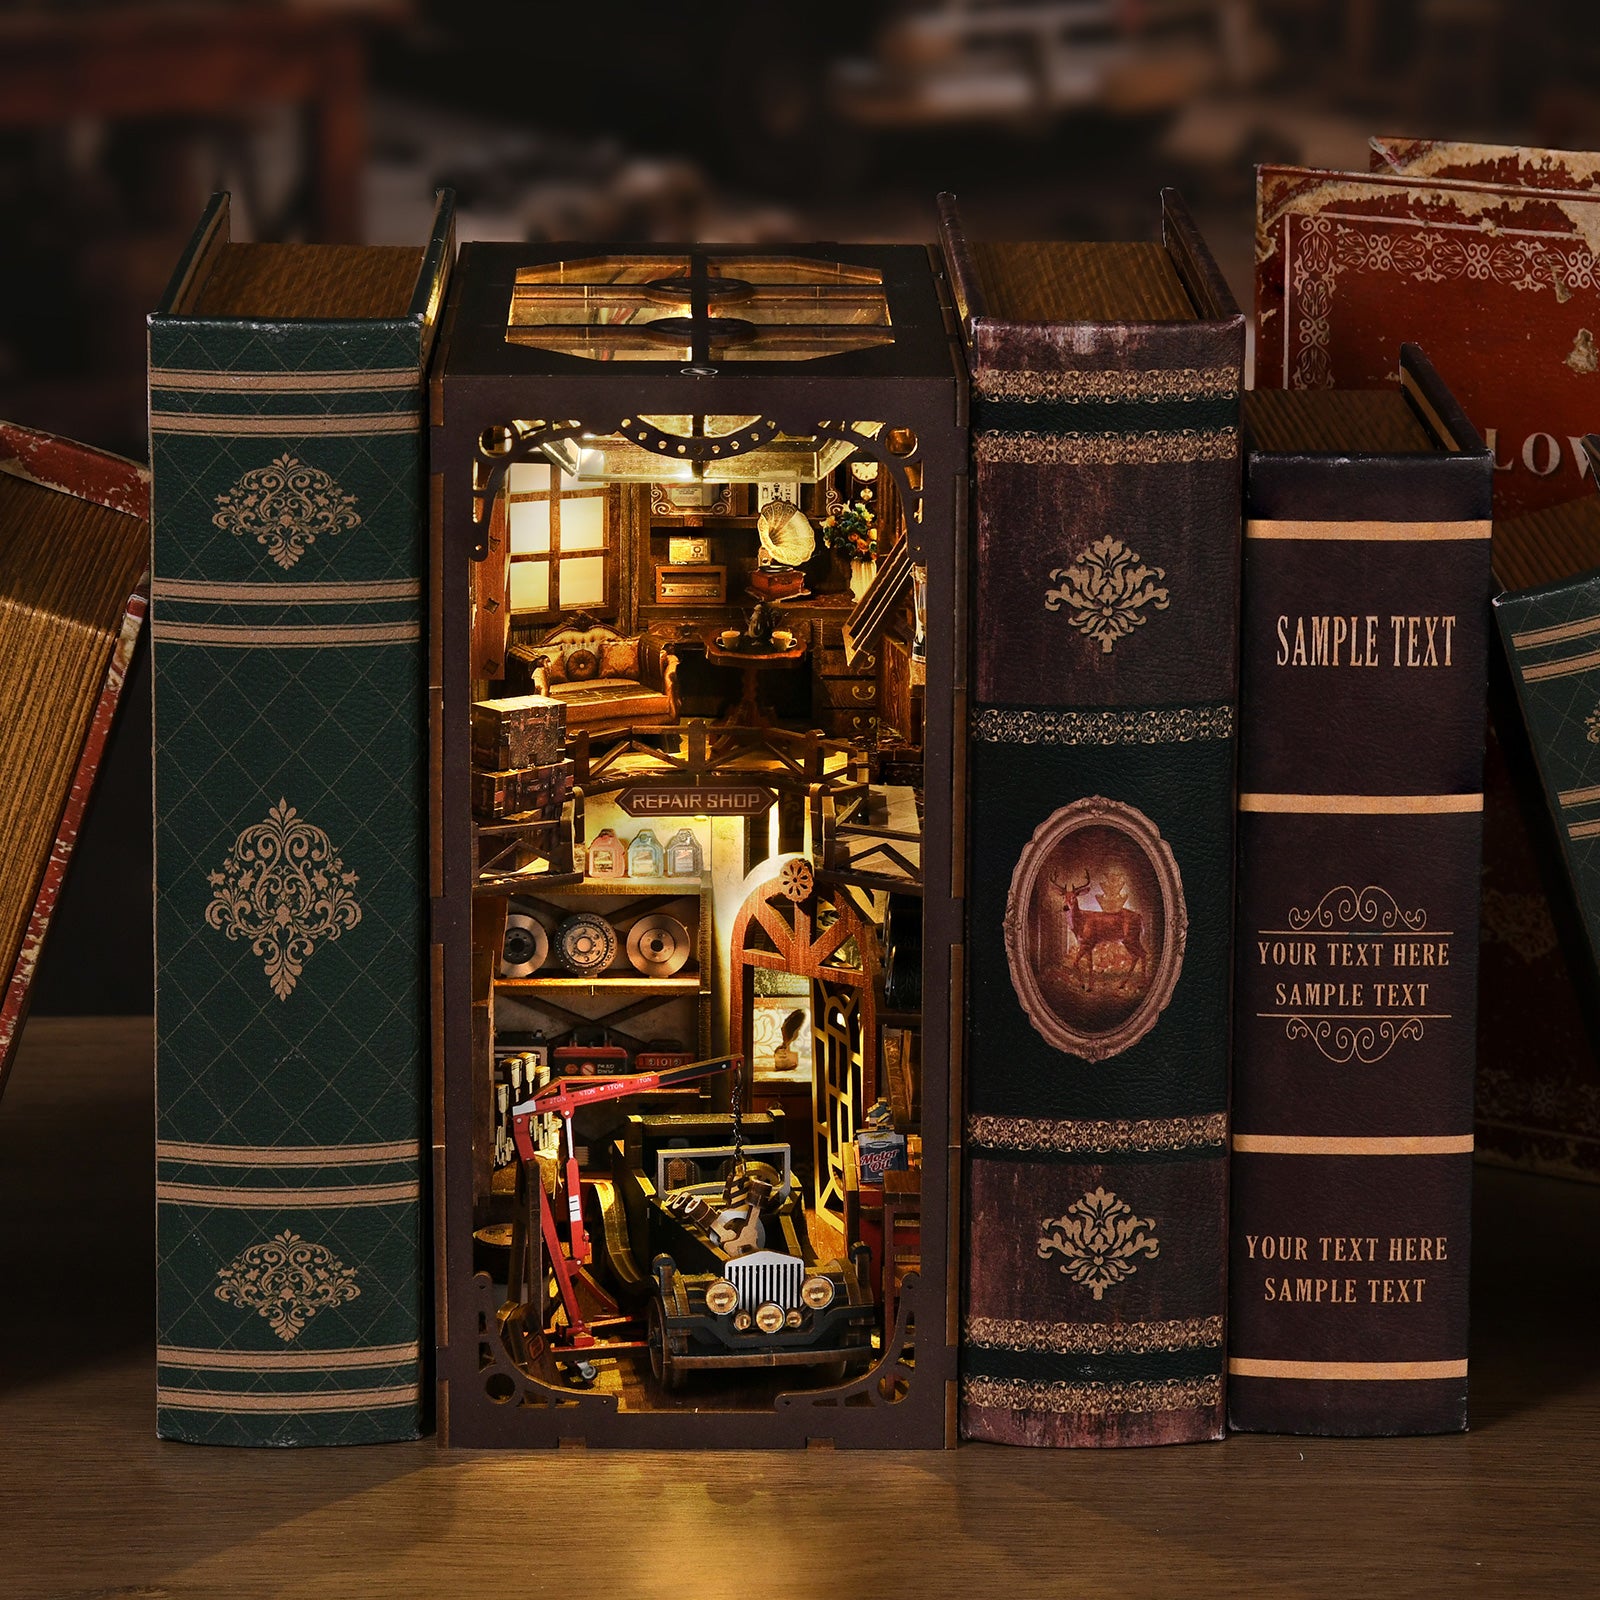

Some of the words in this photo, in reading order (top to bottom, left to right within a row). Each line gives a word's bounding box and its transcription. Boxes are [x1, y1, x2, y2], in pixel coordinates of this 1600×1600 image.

[1276, 615, 1379, 667] SAMPLE
[1391, 615, 1456, 667] TEXT
[632, 794, 701, 809] REPAIR
[706, 793, 760, 808] SHOP
[1257, 942, 1317, 966] YOUR
[1328, 943, 1384, 966] TEXT
[1394, 943, 1449, 966] HERE
[1276, 983, 1363, 1007] SAMPLE
[1374, 984, 1429, 1006] TEXT
[860, 1149, 900, 1166] Motor
[869, 1160, 892, 1173] Oil
[1246, 1236, 1308, 1261] YOUR
[1320, 1237, 1379, 1262] TEXT
[1389, 1238, 1448, 1262] HERE
[1264, 1277, 1357, 1303] SAMPLE
[1367, 1279, 1426, 1303] TEXT
